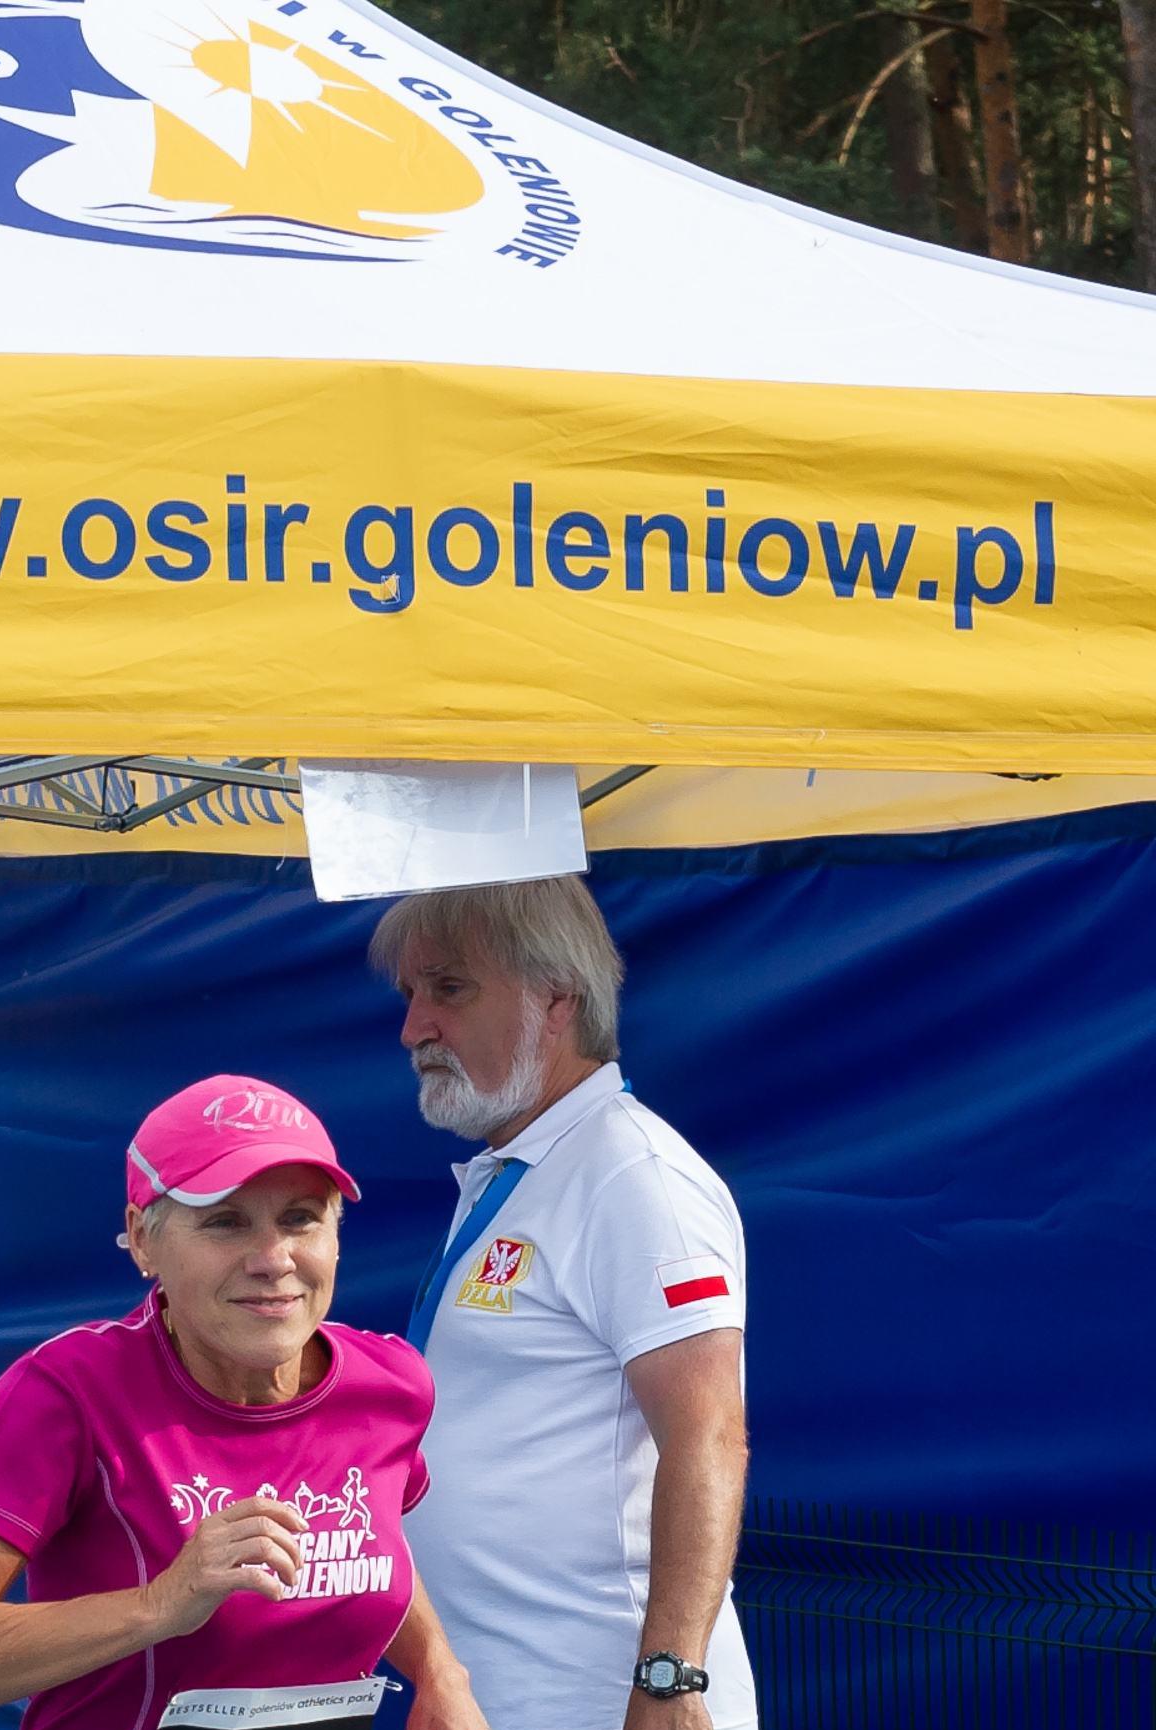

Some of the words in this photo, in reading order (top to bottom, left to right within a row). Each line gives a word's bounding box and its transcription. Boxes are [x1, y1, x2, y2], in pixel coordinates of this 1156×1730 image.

[398, 76, 582, 269] GOLENIOWIE
[202, 1090, 308, 1133] Run
[168, 1703, 246, 1717] BESTSELLER
[346, 1692, 376, 1707] park
